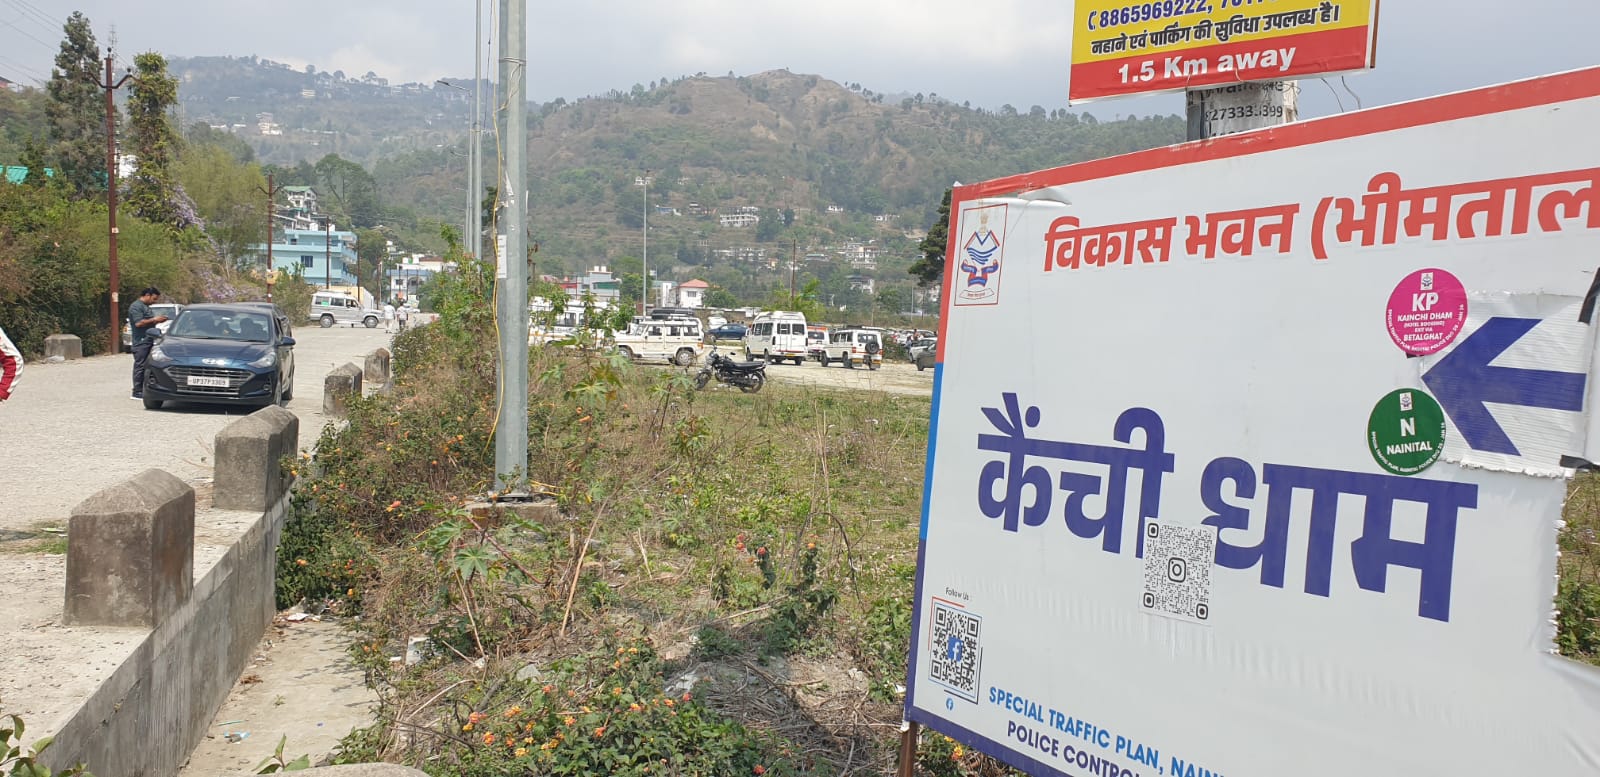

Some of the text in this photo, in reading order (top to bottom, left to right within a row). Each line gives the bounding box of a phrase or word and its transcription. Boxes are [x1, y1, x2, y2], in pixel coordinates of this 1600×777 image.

[1091, 33, 1128, 54] नहाने
[1129, 30, 1148, 49] एवं
[1193, 19, 1213, 39] की
[1214, 15, 1261, 41] सुविधा
[1262, 8, 1317, 30] उपलब्ध
[1118, 47, 1296, 84] 1.5 Km away
[1044, 216, 1177, 272] विकास
[1185, 203, 1300, 260] भवन
[1397, 312, 1453, 322] KAINCHI DHAM
[1412, 292, 1439, 312] KP
[1400, 417, 1416, 437] N
[1386, 441, 1433, 455] NAINITAL
[977, 392, 1479, 623] कैंची धाम
[989, 686, 1044, 723] SPECIAL
[1049, 709, 1110, 748] TRAFFIC
[1115, 735, 1164, 775] PLAN,
[1007, 720, 1059, 758] POLICE
